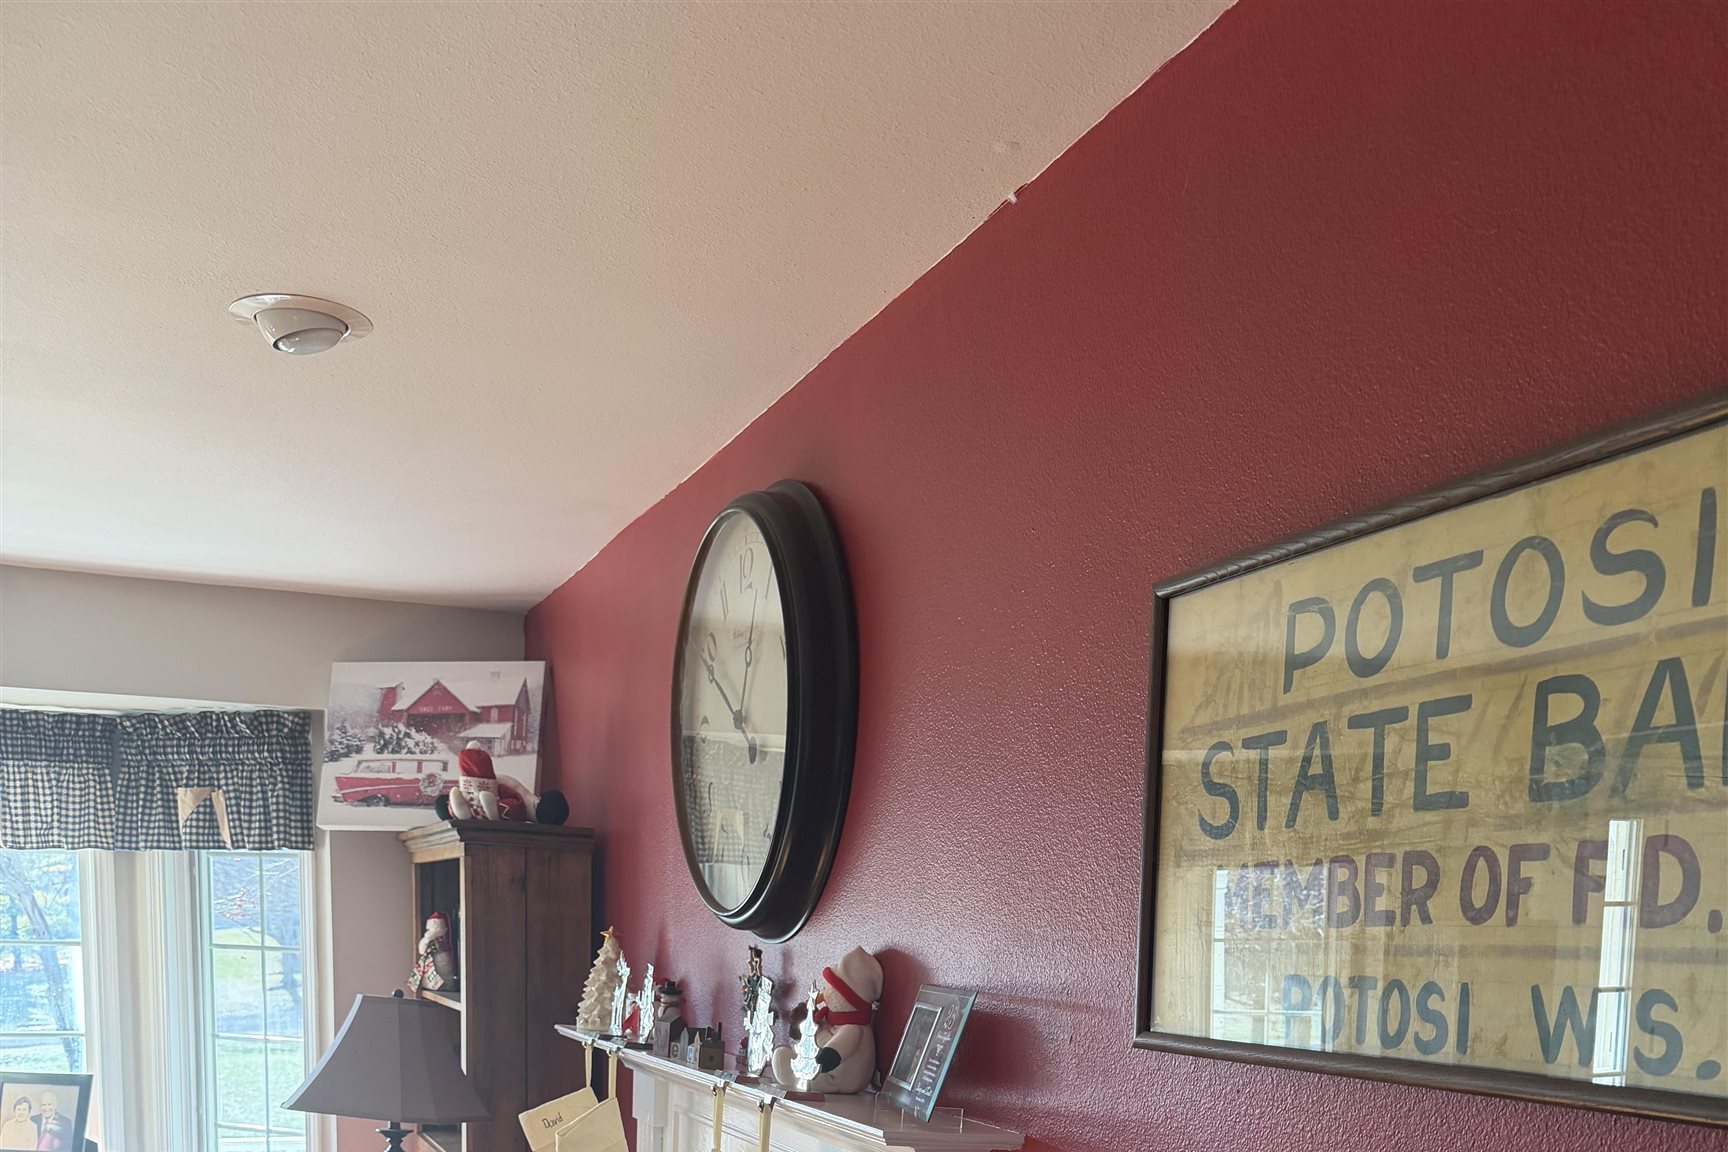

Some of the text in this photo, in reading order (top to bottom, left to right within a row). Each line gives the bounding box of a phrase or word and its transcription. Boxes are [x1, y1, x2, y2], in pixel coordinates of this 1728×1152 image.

[739, 547, 754, 594] 12
[1283, 487, 1718, 694] POTOSI
[1197, 656, 1728, 841] STATE BA
[1216, 849, 1441, 931] MEMBER
[1459, 843, 1551, 928] OF
[1282, 973, 1722, 1081] POTOSI WS.
[541, 1111, 564, 1129] David
